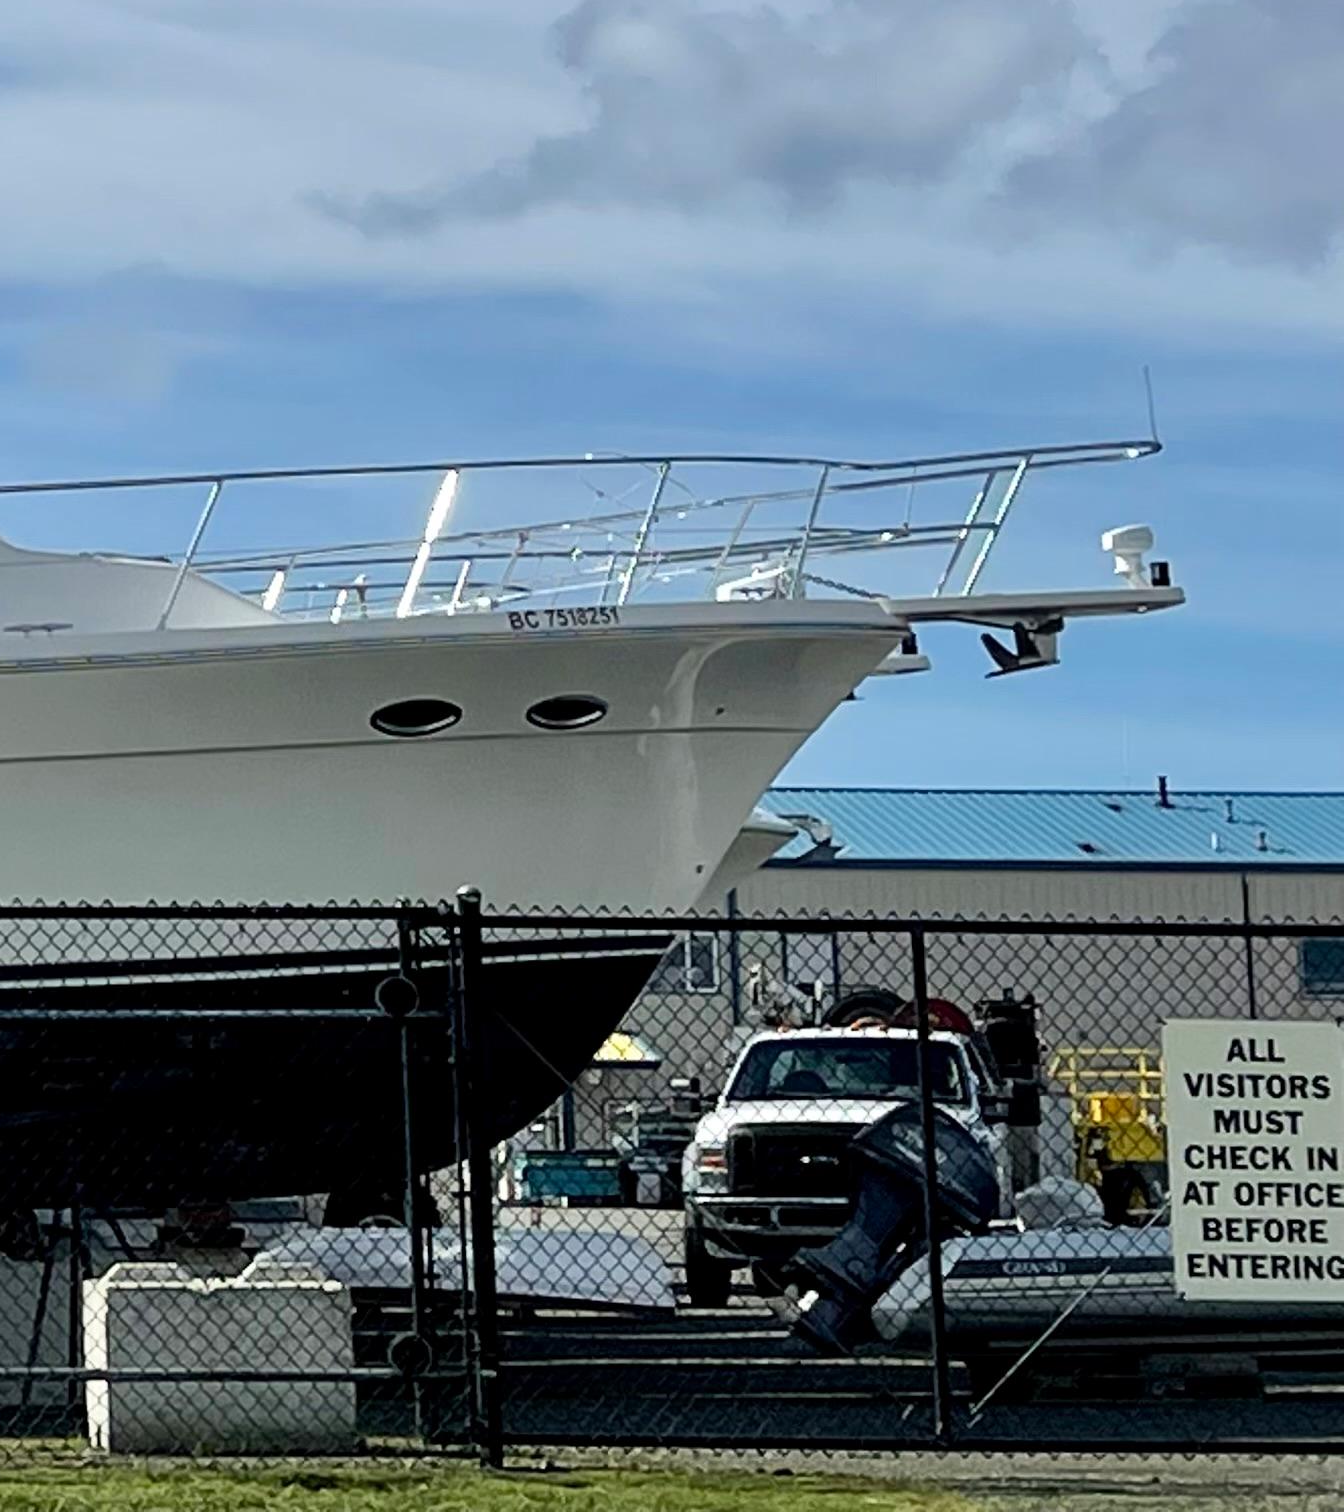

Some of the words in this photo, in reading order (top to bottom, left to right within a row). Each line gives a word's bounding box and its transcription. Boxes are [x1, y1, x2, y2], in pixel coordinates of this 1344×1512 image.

[509, 611, 539, 629] BC
[544, 606, 619, 627] 7518251
[1227, 1039, 1285, 1063] ALL
[1183, 1073, 1331, 1099] VISITORS
[1214, 1110, 1303, 1135] MUST
[1184, 1144, 1292, 1170] CHECK
[1307, 1147, 1338, 1171] IN
[1183, 1181, 1220, 1206] AT
[1234, 1182, 1344, 1208] OFFICE
[1202, 1217, 1328, 1244] BEFORE
[1187, 1253, 1344, 1281] ENTERING
